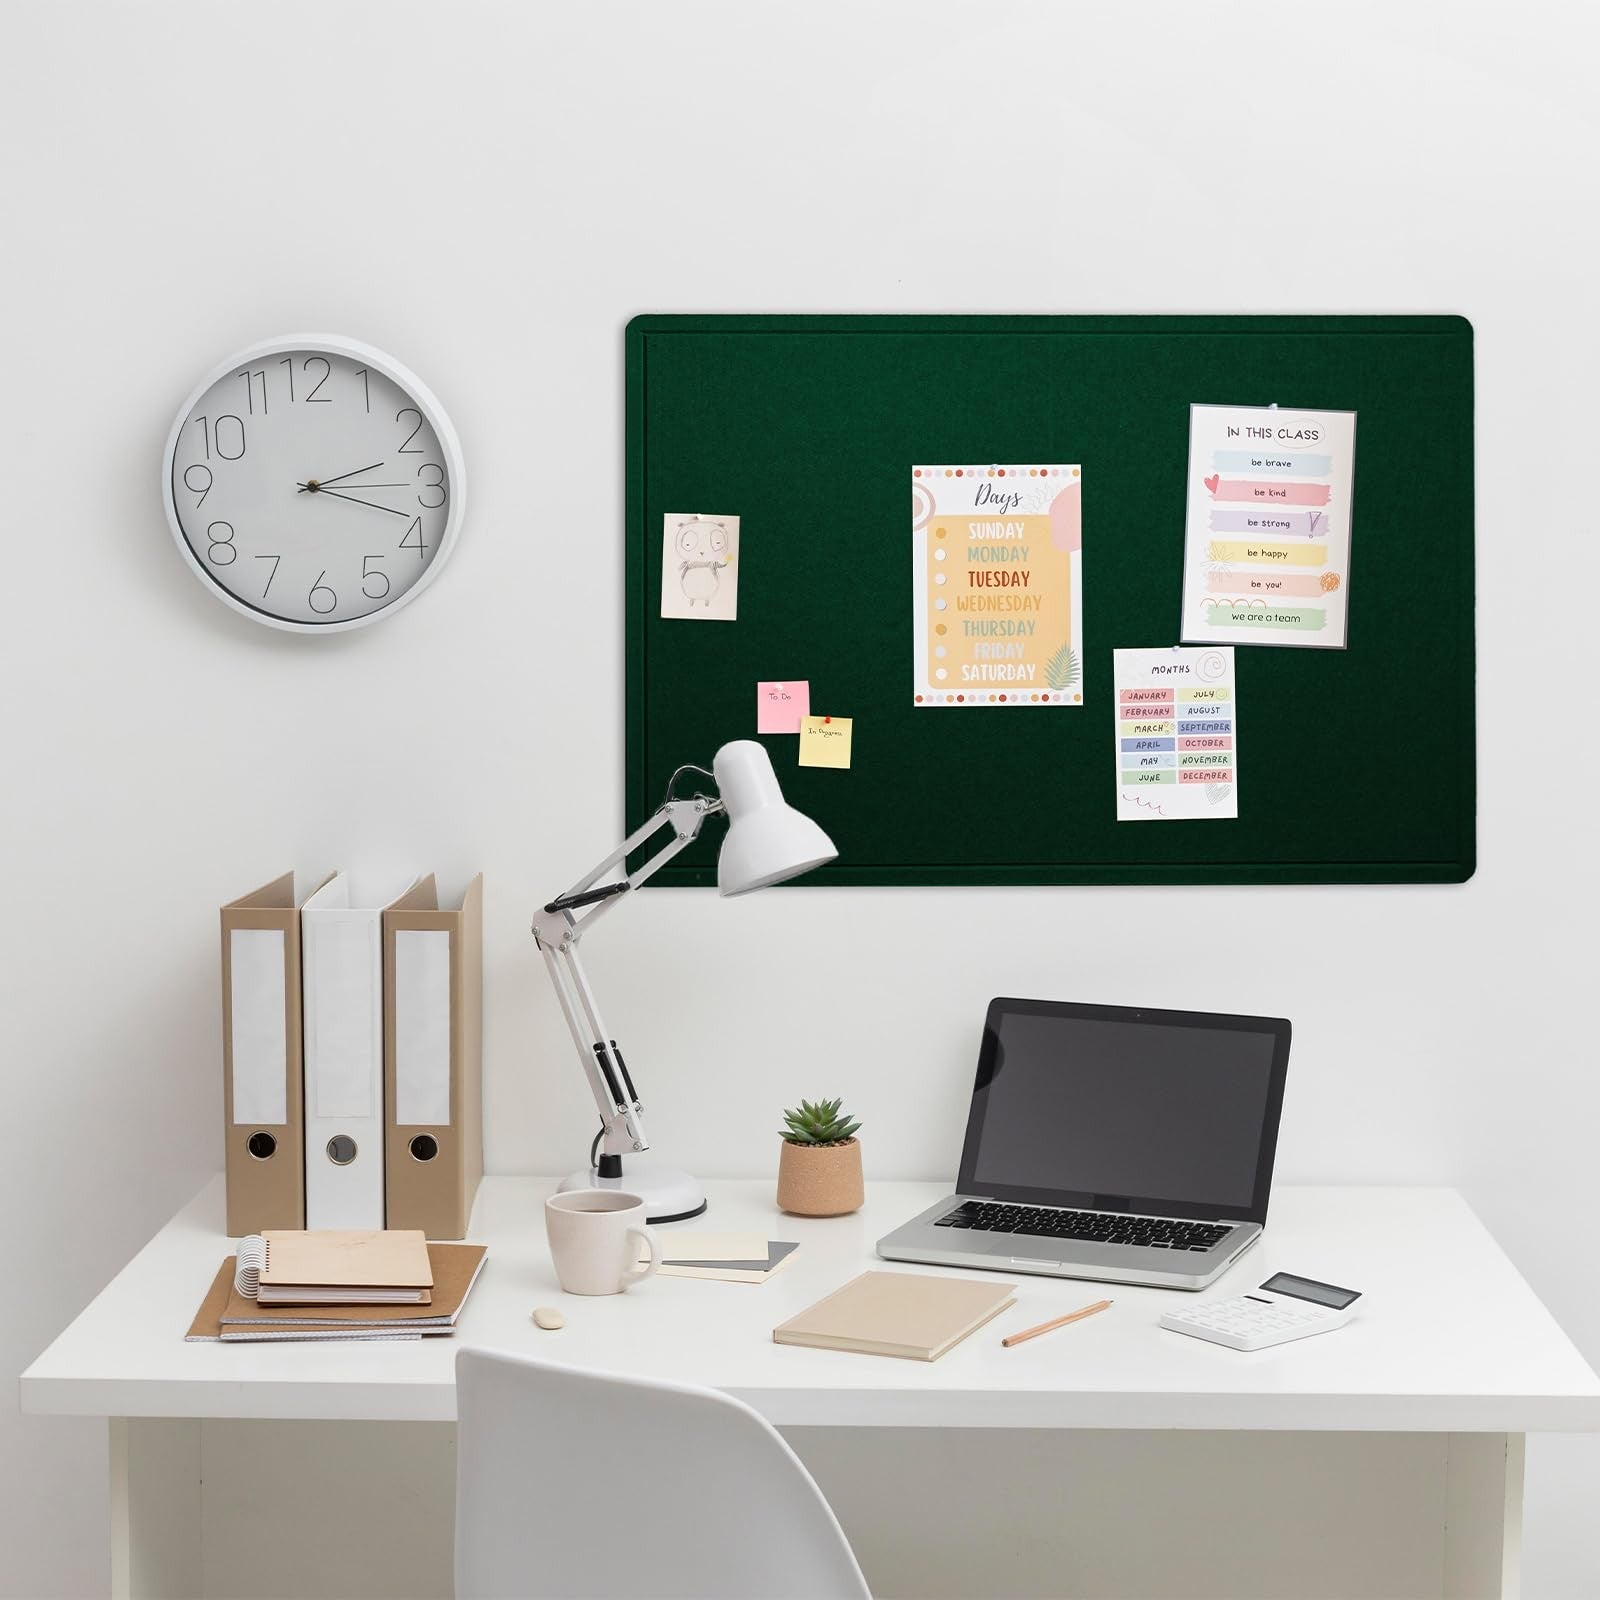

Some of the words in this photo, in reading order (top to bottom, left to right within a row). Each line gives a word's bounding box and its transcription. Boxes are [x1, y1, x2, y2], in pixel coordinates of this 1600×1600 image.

[280, 357, 333, 402] 12
[238, 371, 267, 415] 11
[355, 369, 369, 413] 1
[195, 415, 245, 460] 10
[396, 408, 424, 453] 2
[1227, 426, 1240, 438] IN
[1246, 427, 1272, 439] THIS
[1278, 429, 1319, 440] CLASS
[1251, 459, 1262, 467] be
[1265, 459, 1292, 468] brave
[184, 464, 213, 509] 9
[418, 463, 446, 508] 3
[974, 483, 1023, 514] Days
[968, 522, 1024, 539] SUNDAY
[1248, 519, 1258, 527] be
[1262, 520, 1291, 529] strong
[207, 521, 236, 565] 8
[399, 516, 429, 559] 4
[967, 546, 1029, 562] MONDAY
[1248, 549, 1258, 557] be
[1261, 550, 1288, 559] happy
[254, 556, 280, 598] 7
[362, 555, 390, 599] 5
[968, 571, 1030, 587] TUESDAY
[1265, 581, 1282, 589] you!
[309, 570, 337, 614] 6
[956, 595, 1042, 612] WEDNESDAY
[1232, 613, 1246, 621] we
[1265, 614, 1272, 622] a
[1274, 614, 1301, 623] team
[963, 620, 1036, 636] THURSDAY
[975, 642, 1025, 660] FRIDAY
[962, 664, 1036, 681] SATURDAY
[1152, 665, 1190, 674] MONTHS
[1128, 691, 1166, 700] JANUARY
[1126, 708, 1170, 716] FEBRUARY
[1188, 707, 1221, 715] AUGUST
[808, 727, 816, 735] In
[1134, 724, 1164, 733] MARCH
[1181, 722, 1231, 731] SEPTEMBER
[1136, 741, 1161, 750] APRIL
[1141, 757, 1158, 766] MAY
[1182, 756, 1228, 765] NOVEMBER
[1138, 773, 1161, 782] JUNE
[1184, 772, 1228, 780] DECEMBER
